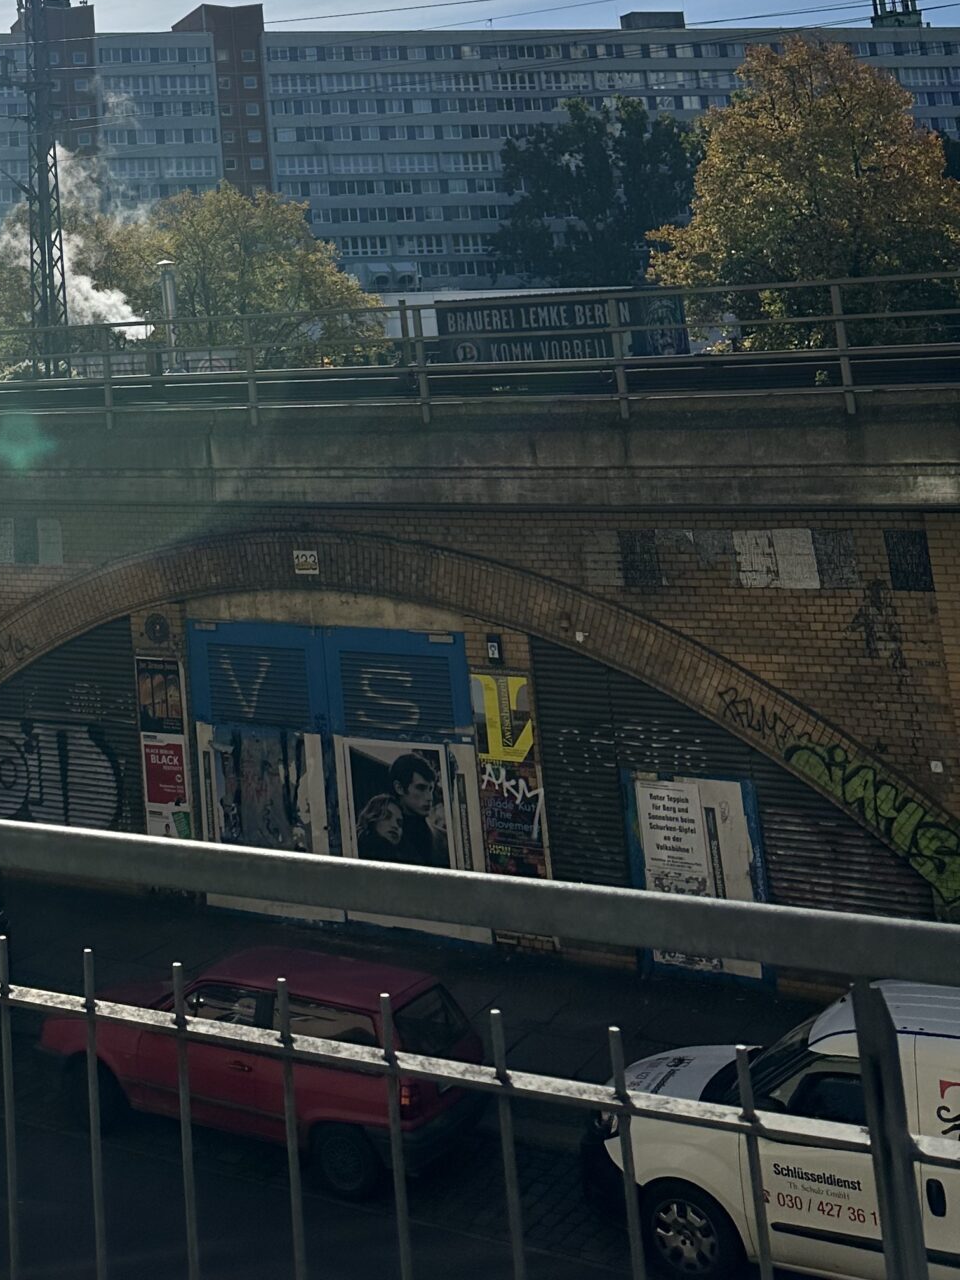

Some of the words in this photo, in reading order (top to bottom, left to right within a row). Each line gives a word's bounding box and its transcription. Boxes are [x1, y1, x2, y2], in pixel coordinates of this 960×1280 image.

[447, 308, 515, 333] BRAUEREI
[520, 305, 569, 329] LEMKE
[490, 342, 535, 362] KOMM
[150, 754, 179, 766] BLACK
[649, 792, 665, 801] Roter
[666, 794, 689, 804] Teppich
[492, 807, 512, 819] The
[652, 803, 661, 811] für
[662, 804, 676, 813] Berg
[678, 806, 688, 814] und
[680, 816, 695, 824] beim
[656, 843, 690, 853] Volksbühne
[773, 1163, 862, 1191] Schlüsseldienst
[801, 1184, 824, 1195] Schulz
[826, 1189, 850, 1201] GmbH
[777, 1192, 803, 1210] 030
[817, 1201, 842, 1218] 427
[847, 1206, 866, 1223] 36
